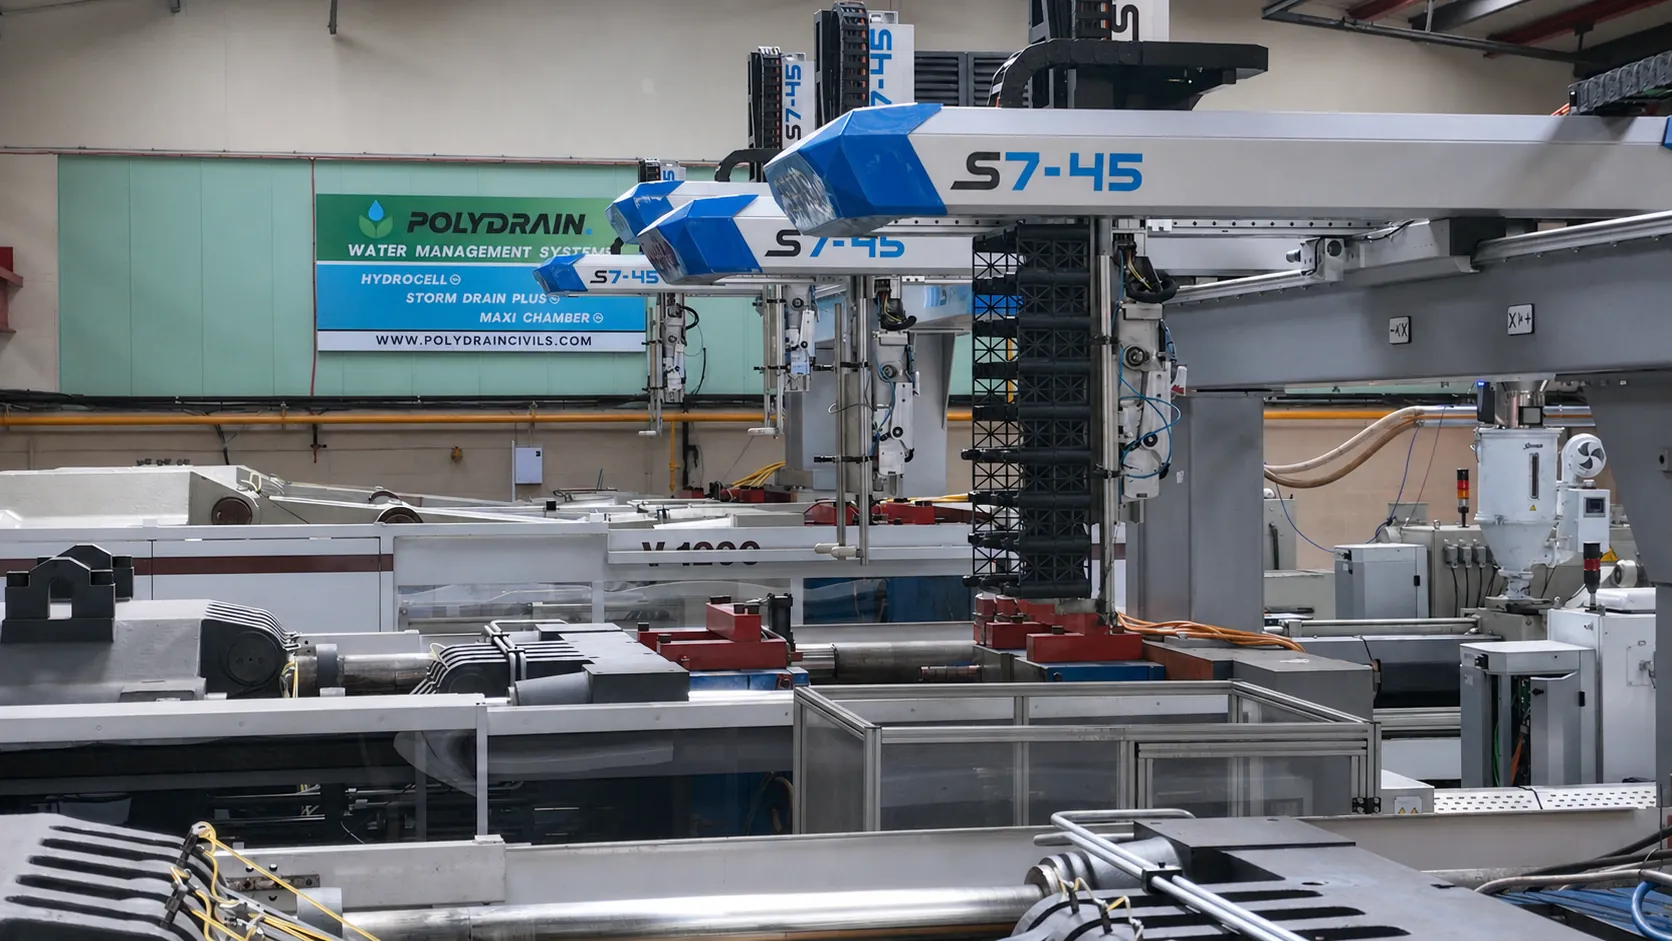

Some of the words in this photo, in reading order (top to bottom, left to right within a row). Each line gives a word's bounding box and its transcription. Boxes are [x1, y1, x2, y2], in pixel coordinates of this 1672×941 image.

[950, 151, 1143, 192] S7-45
[348, 244, 407, 258] WATER
[415, 245, 532, 259] MANAGEMENT
[361, 273, 448, 286] HYDROCELL
[590, 270, 659, 284] S7-45
[406, 292, 457, 304] STORM
[462, 292, 507, 304] DRAIN
[512, 293, 548, 304] PLUS
[480, 312, 516, 324] MAXI
[523, 312, 590, 324] CHAMBER
[376, 335, 592, 347] WWW.POLYDRAINCIVILS.COM
